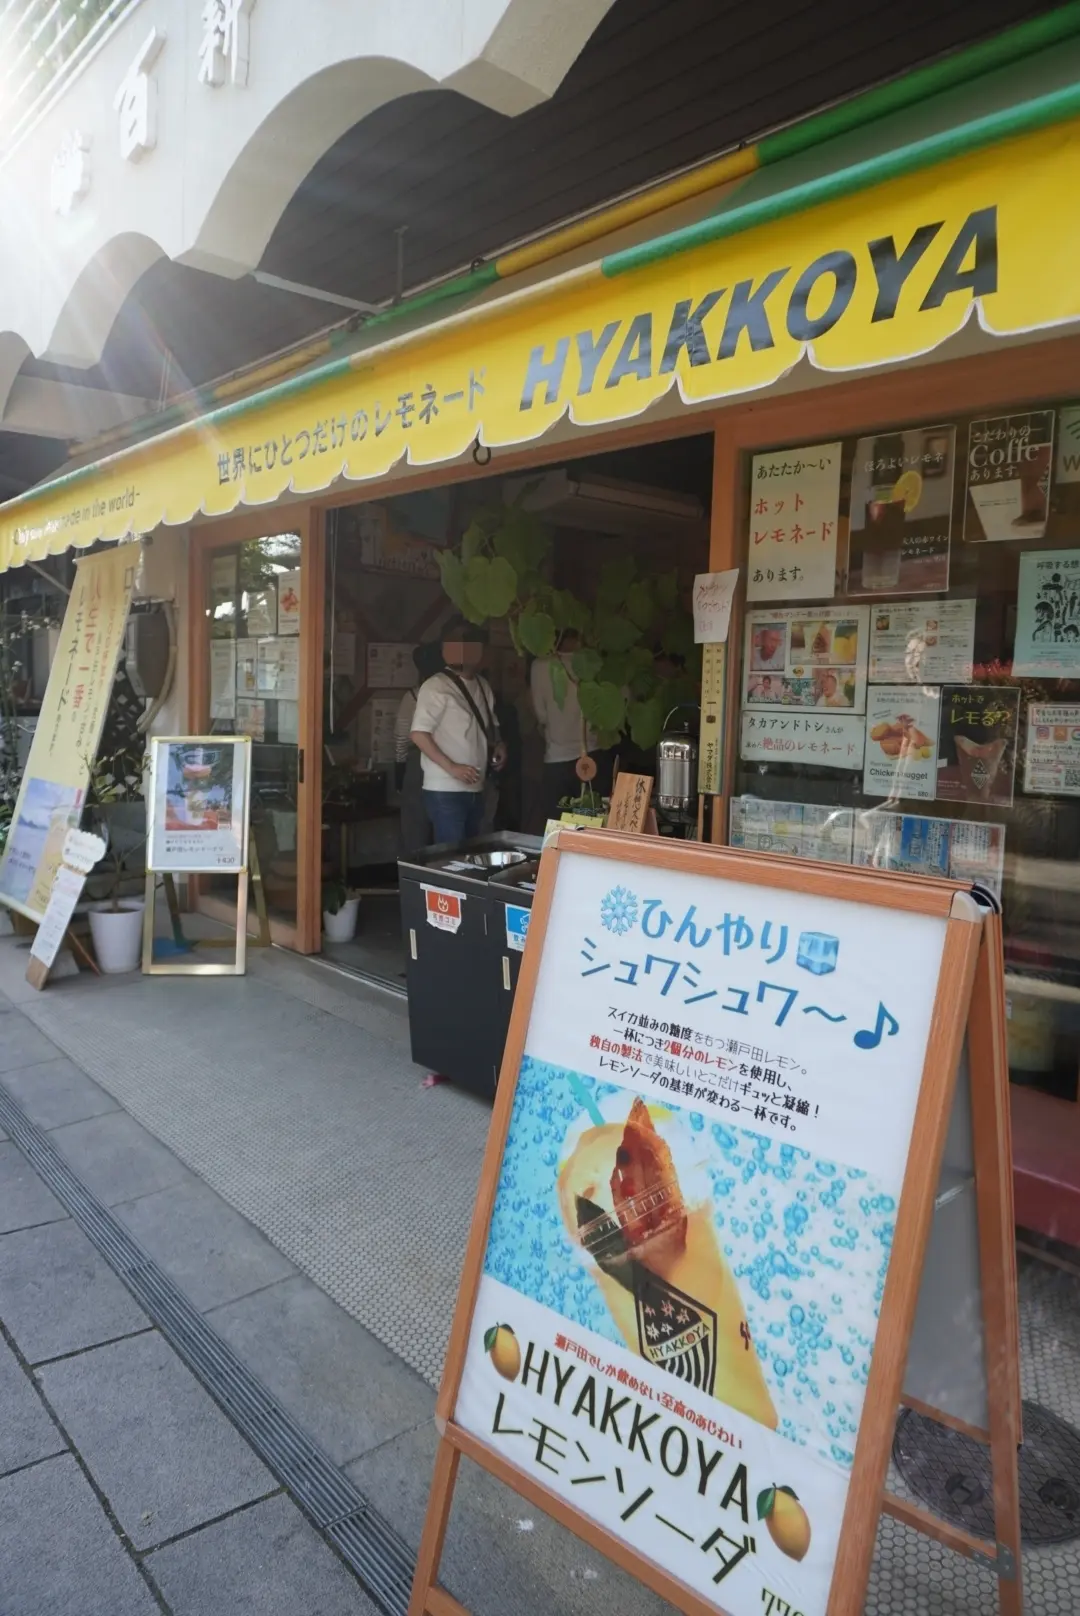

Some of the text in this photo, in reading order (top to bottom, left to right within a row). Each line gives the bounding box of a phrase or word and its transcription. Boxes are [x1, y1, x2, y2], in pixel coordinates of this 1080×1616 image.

[519, 204, 998, 413] HYAKKOYA
[217, 366, 487, 486] 世界にひとつだけのレモネード
[973, 425, 1031, 443] こだわりの
[757, 457, 832, 480] あたたか〜い
[970, 437, 1040, 468] Coffe
[970, 465, 1020, 481] あります。
[92, 499, 106, 518] the
[754, 493, 805, 515] ホット
[754, 521, 835, 545] レモネード
[753, 566, 805, 583] あります。
[951, 694, 985, 704] ホットで
[748, 717, 844, 734] タカアンドトシさんが
[641, 899, 789, 964] ひんやり
[581, 936, 847, 1027] シュワシュワ〜
[607, 1006, 807, 1075] スイカ並みの糖度をもつ瀬戸田レモン。
[613, 1027, 792, 1092] 一杯につき2個分のレモンを使用し、
[589, 1034, 820, 1118] 独自の製法で美味しいとこだけギュッと凝縮!
[599, 1055, 796, 1131] レモンソーダの基準が変わる一杯です。
[649, 1322, 711, 1359] HYAKKOYA
[554, 1332, 743, 1449] 瀬戸田でしか飲めない至高のあじわい
[521, 1341, 749, 1524] HYAKKOYA
[491, 1392, 757, 1584] レモンソーダ
